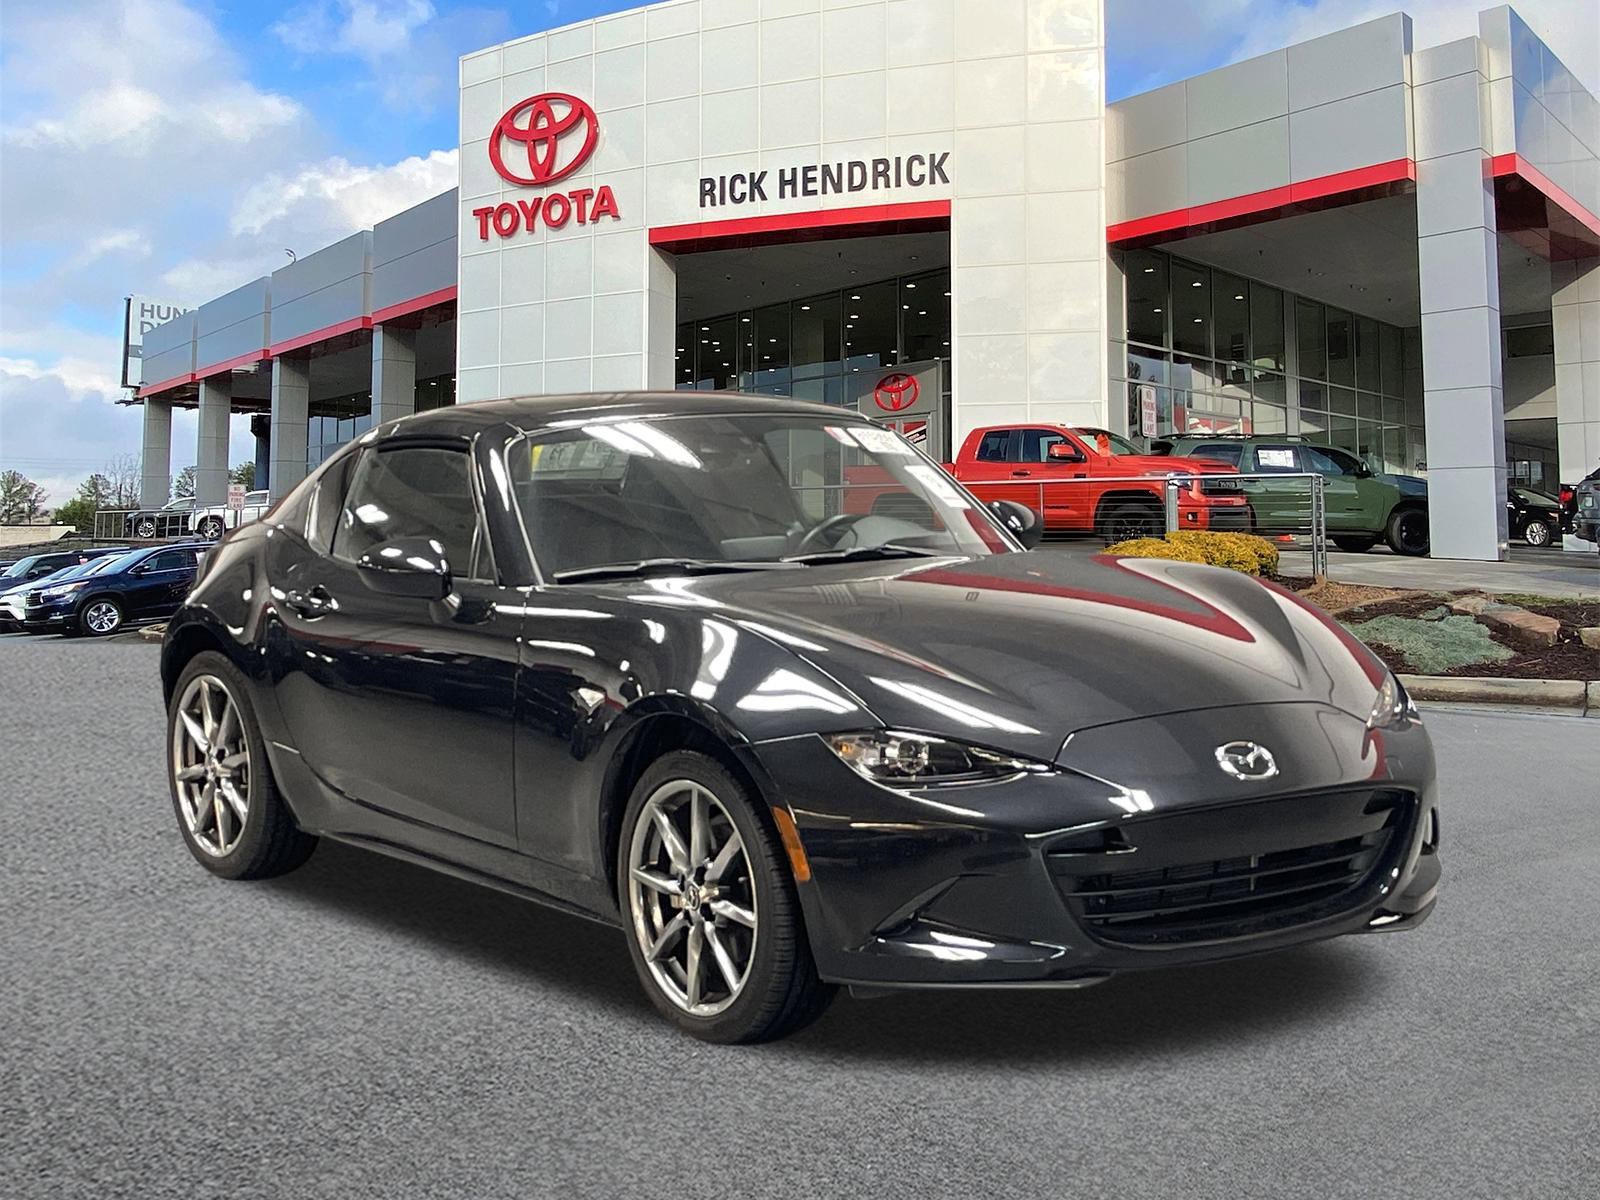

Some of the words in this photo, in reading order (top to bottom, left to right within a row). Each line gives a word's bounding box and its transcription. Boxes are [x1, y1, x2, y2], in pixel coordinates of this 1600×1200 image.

[699, 170, 768, 208] RICK
[778, 151, 951, 200] HENDRICK
[472, 185, 621, 240] TOYOTA
